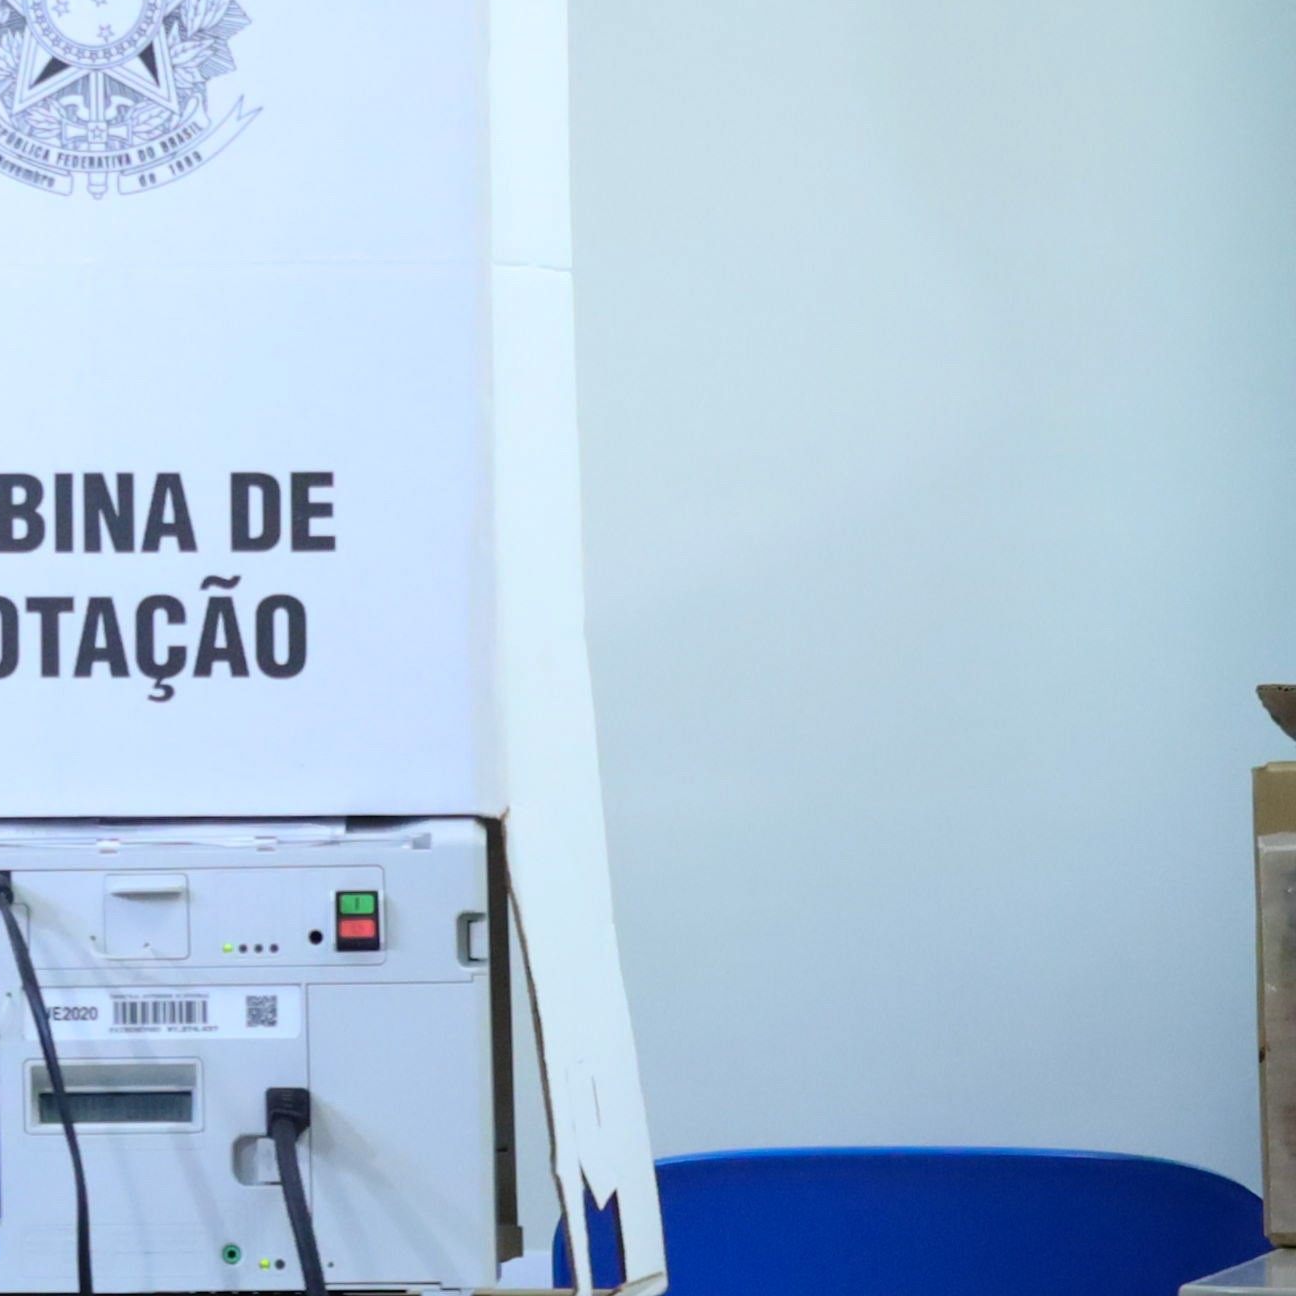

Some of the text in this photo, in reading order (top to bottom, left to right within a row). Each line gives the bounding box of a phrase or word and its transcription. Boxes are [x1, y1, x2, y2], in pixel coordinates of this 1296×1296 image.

[56, 152, 132, 169] FEDERATIVA
[137, 146, 156, 162] DO
[160, 121, 203, 153] BRASIL
[230, 471, 336, 553] DE
